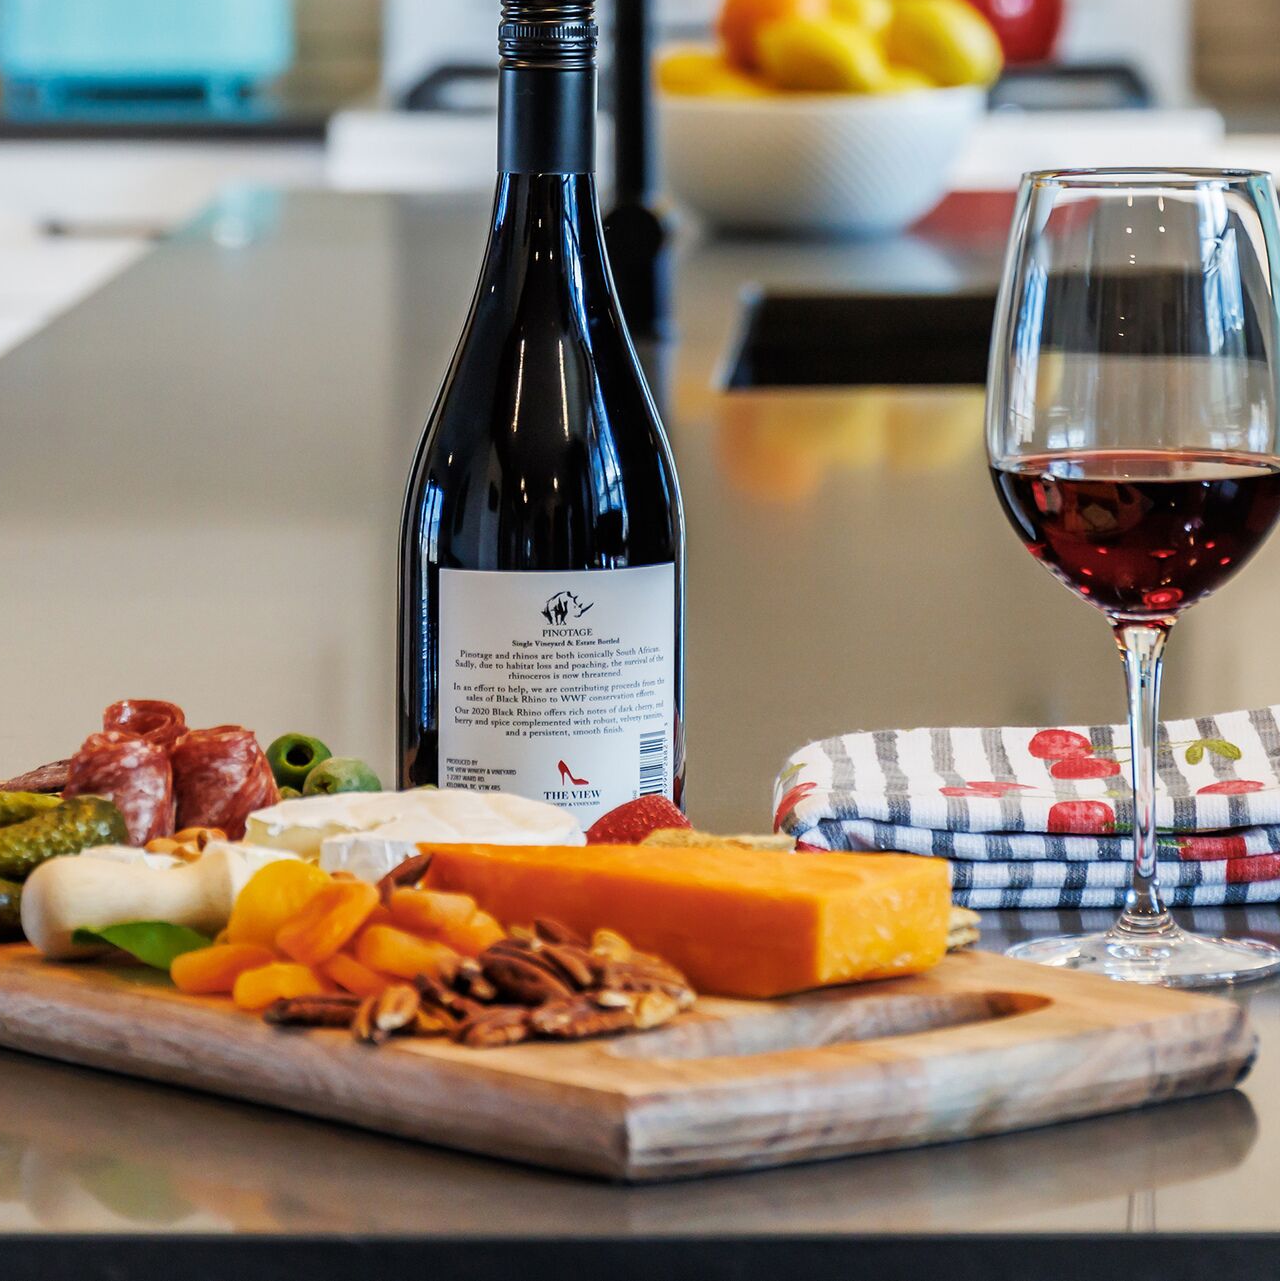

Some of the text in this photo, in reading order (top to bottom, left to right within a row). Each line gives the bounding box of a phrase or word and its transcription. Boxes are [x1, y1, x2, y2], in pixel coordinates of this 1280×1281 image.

[542, 628, 593, 638] PINOTAGE
[512, 640, 533, 648] Single
[535, 640, 565, 648] Vineyard
[597, 637, 620, 645] Bottled
[460, 649, 492, 661] Pinotage
[495, 652, 510, 660] and
[512, 652, 538, 660] rhinos
[555, 651, 575, 660] both
[577, 650, 614, 660] iconically
[615, 648, 636, 657] South
[455, 659, 477, 670] Sadly,
[479, 661, 493, 669] due
[495, 662, 504, 670] to
[506, 662, 534, 670] habitat
[536, 662, 552, 670] loss
[554, 662, 569, 670] and
[571, 661, 609, 671] poaching,
[624, 657, 648, 665] survival
[508, 672, 551, 680] rhinoceros
[553, 672, 560, 680] is
[453, 682, 461, 691] In
[473, 684, 495, 692] effort
[497, 685, 506, 693] to
[508, 685, 528, 695] help,
[560, 684, 609, 694] contributing
[611, 680, 640, 691] proceeds
[641, 678, 656, 687] from
[466, 694, 483, 702] sales
[485, 694, 495, 702] of
[496, 694, 519, 703] Black
[521, 695, 547, 703] Rhino
[560, 694, 587, 702] WWF
[588, 692, 635, 701] conservation
[454, 705, 470, 715] Our
[471, 707, 490, 716] 2020
[492, 708, 514, 716] Black
[516, 708, 542, 717] Rhino
[544, 708, 567, 717] offers
[568, 708, 585, 716] rich
[608, 705, 618, 714] of
[618, 704, 633, 713] dark
[454, 716, 473, 727] berry
[490, 719, 510, 728] spice
[512, 718, 571, 729] complemented
[593, 716, 618, 725] robust,
[619, 714, 641, 723] velvety
[529, 729, 571, 739] persistent,
[572, 728, 601, 736] smooth
[446, 758, 471, 766] PRODUCED
[491, 768, 517, 776] VINEYARD
[543, 790, 601, 800] THE VIEW
